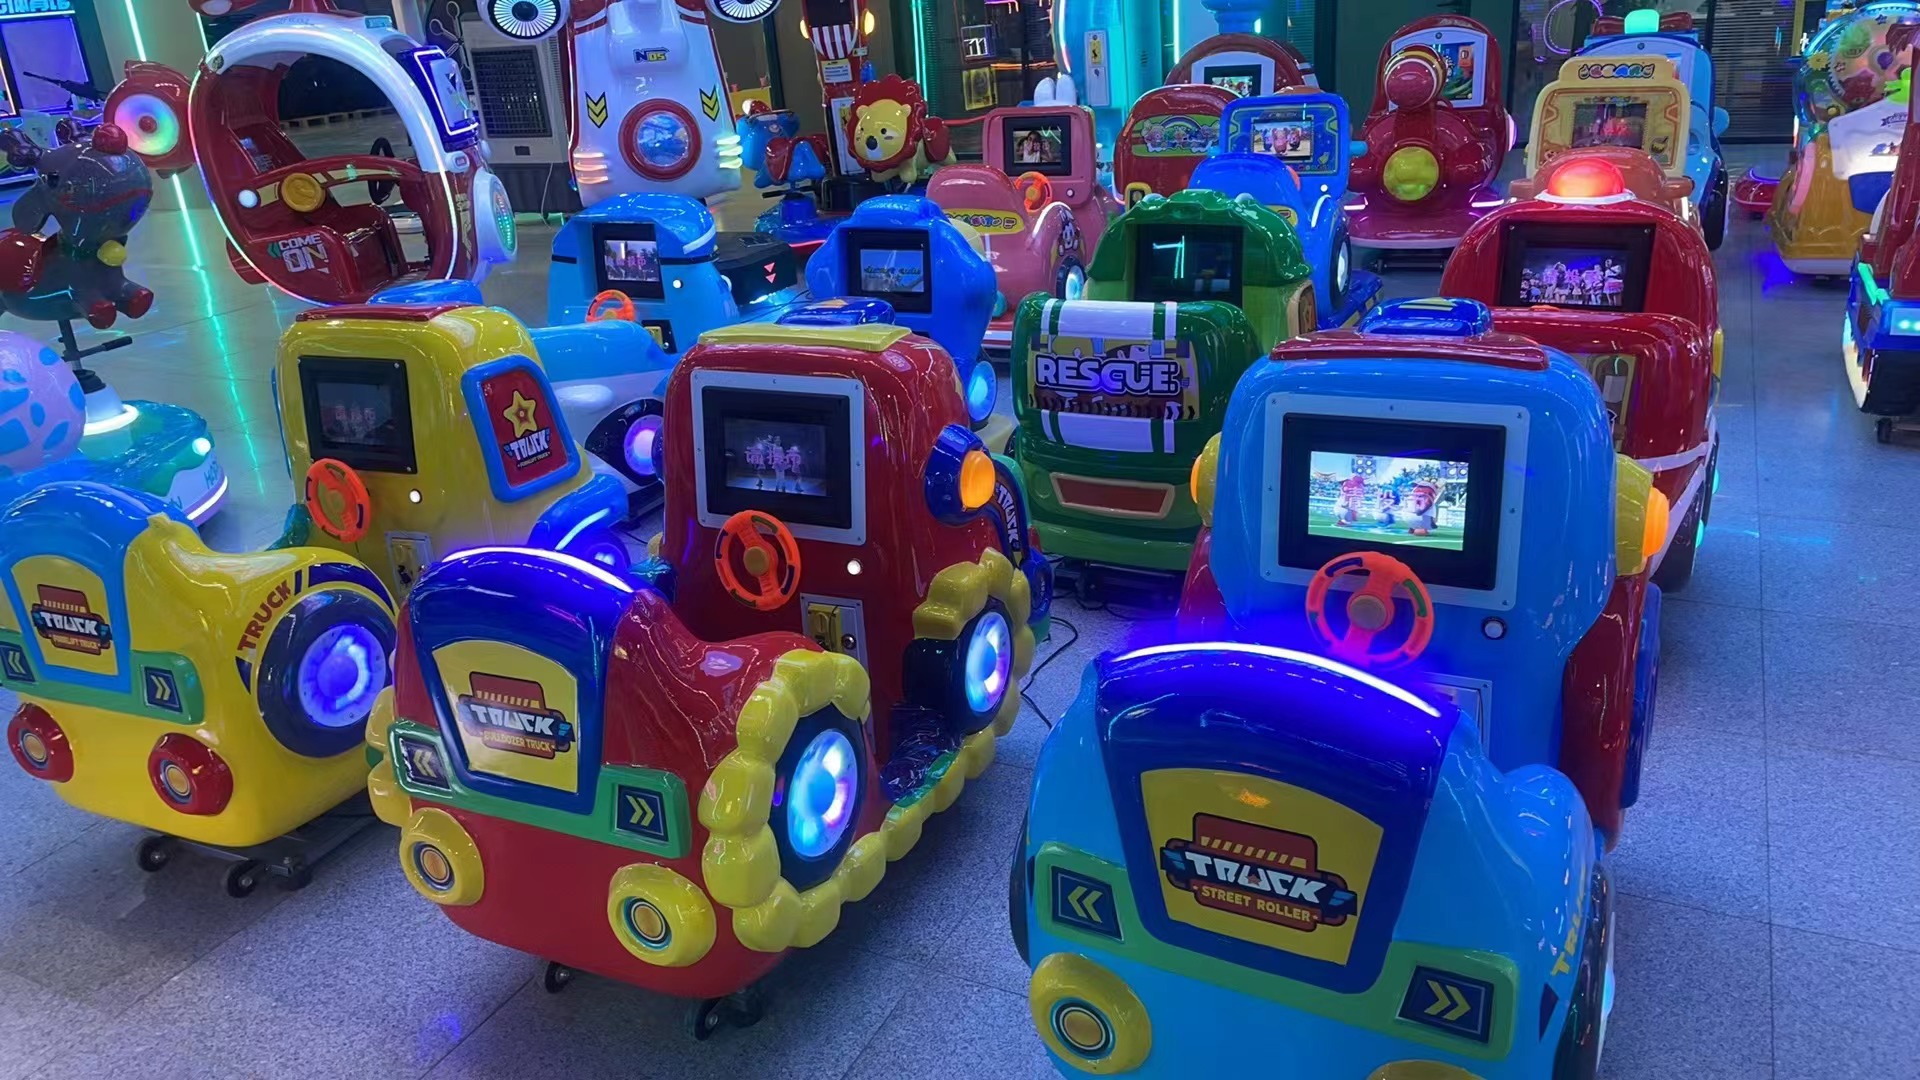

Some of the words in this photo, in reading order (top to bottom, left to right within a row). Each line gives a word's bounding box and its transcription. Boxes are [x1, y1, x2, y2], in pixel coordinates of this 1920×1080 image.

[280, 233, 322, 250] COME
[1036, 354, 1179, 396] RESCUE
[509, 429, 549, 461] TRUCK
[40, 611, 99, 636] TRUCK
[236, 579, 291, 651] TRUCK
[470, 703, 555, 736] TRUCK
[525, 738, 552, 753] TRUCK
[1185, 851, 1328, 904] TRUCK
[1201, 885, 1252, 908] STREET
[1256, 899, 1311, 923] ROLLER
